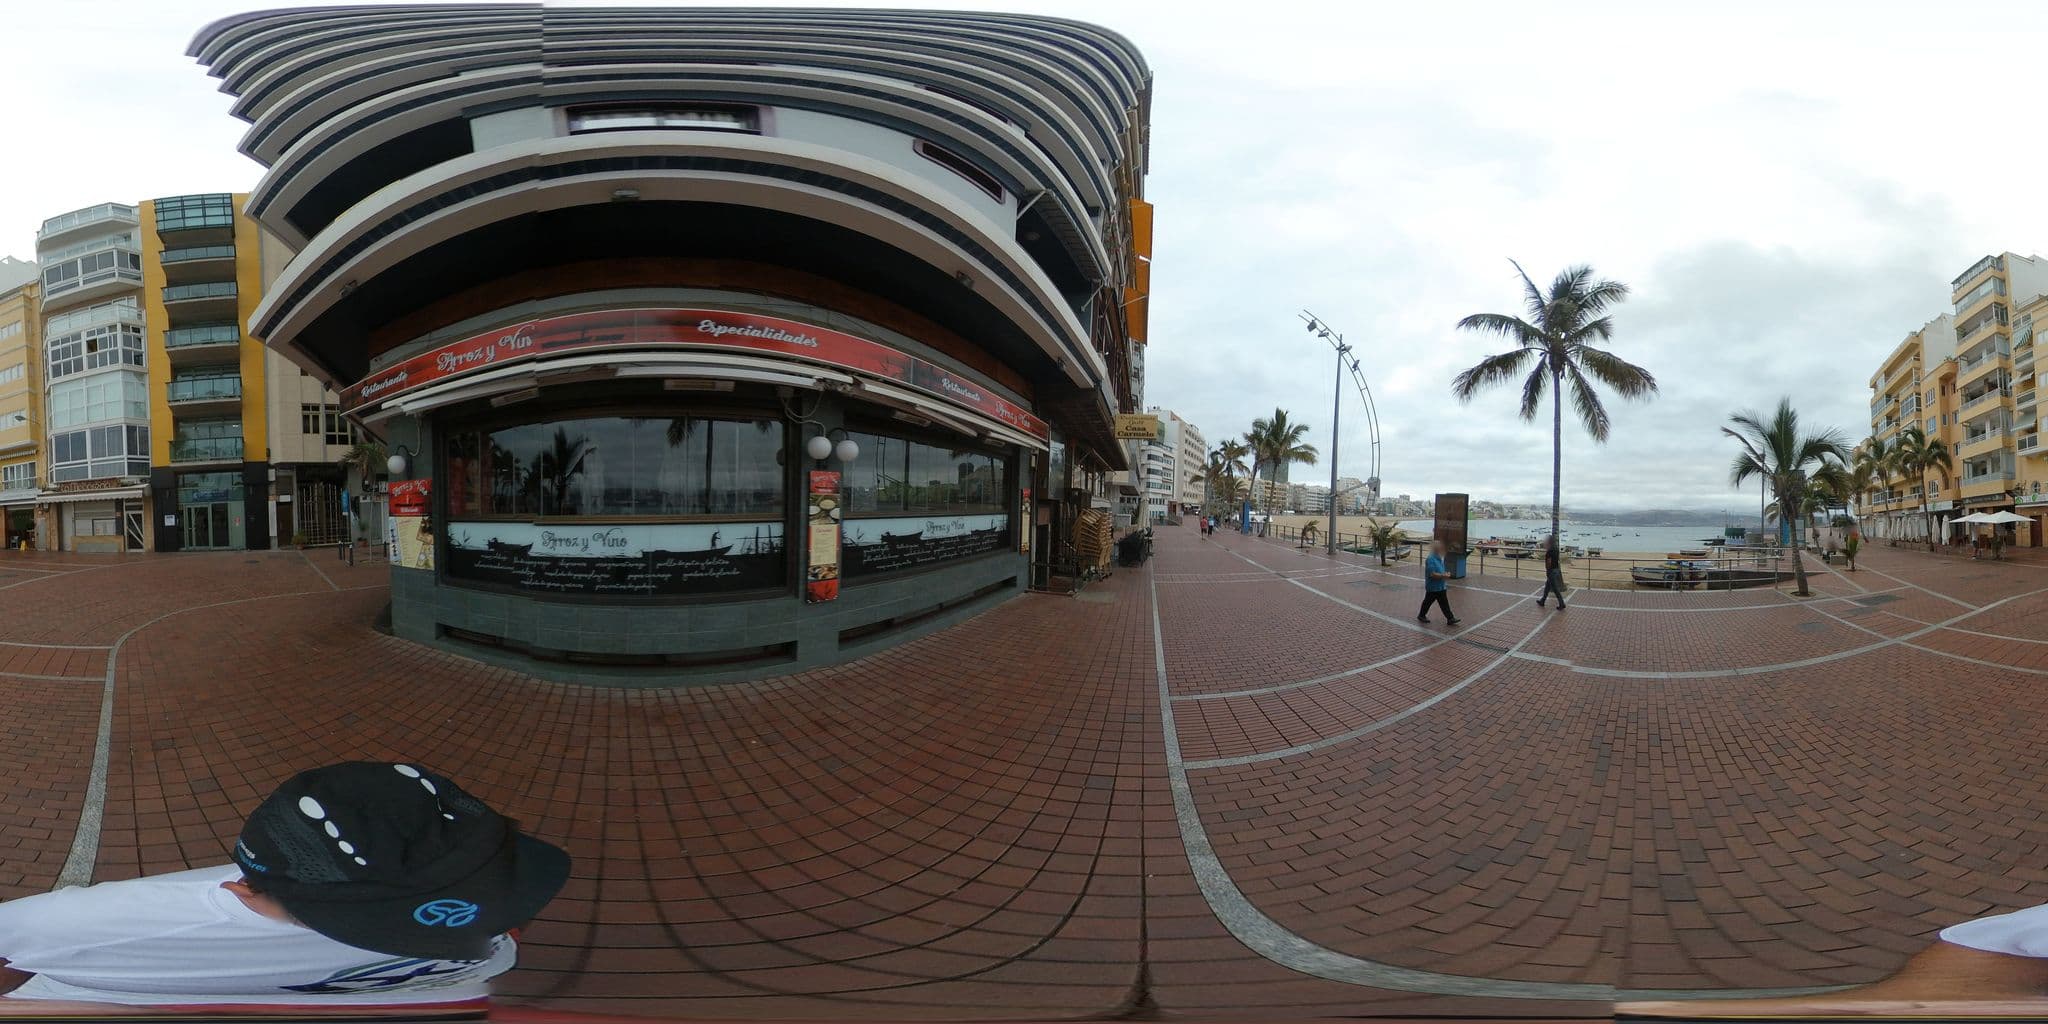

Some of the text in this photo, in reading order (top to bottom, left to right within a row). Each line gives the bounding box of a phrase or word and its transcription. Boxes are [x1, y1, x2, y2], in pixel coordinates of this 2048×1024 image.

[697, 319, 818, 348] Especialidades
[437, 348, 484, 373] Arroz
[486, 344, 496, 363] y
[361, 371, 408, 397] Restaurante
[541, 527, 628, 552] Arroz y Vino
